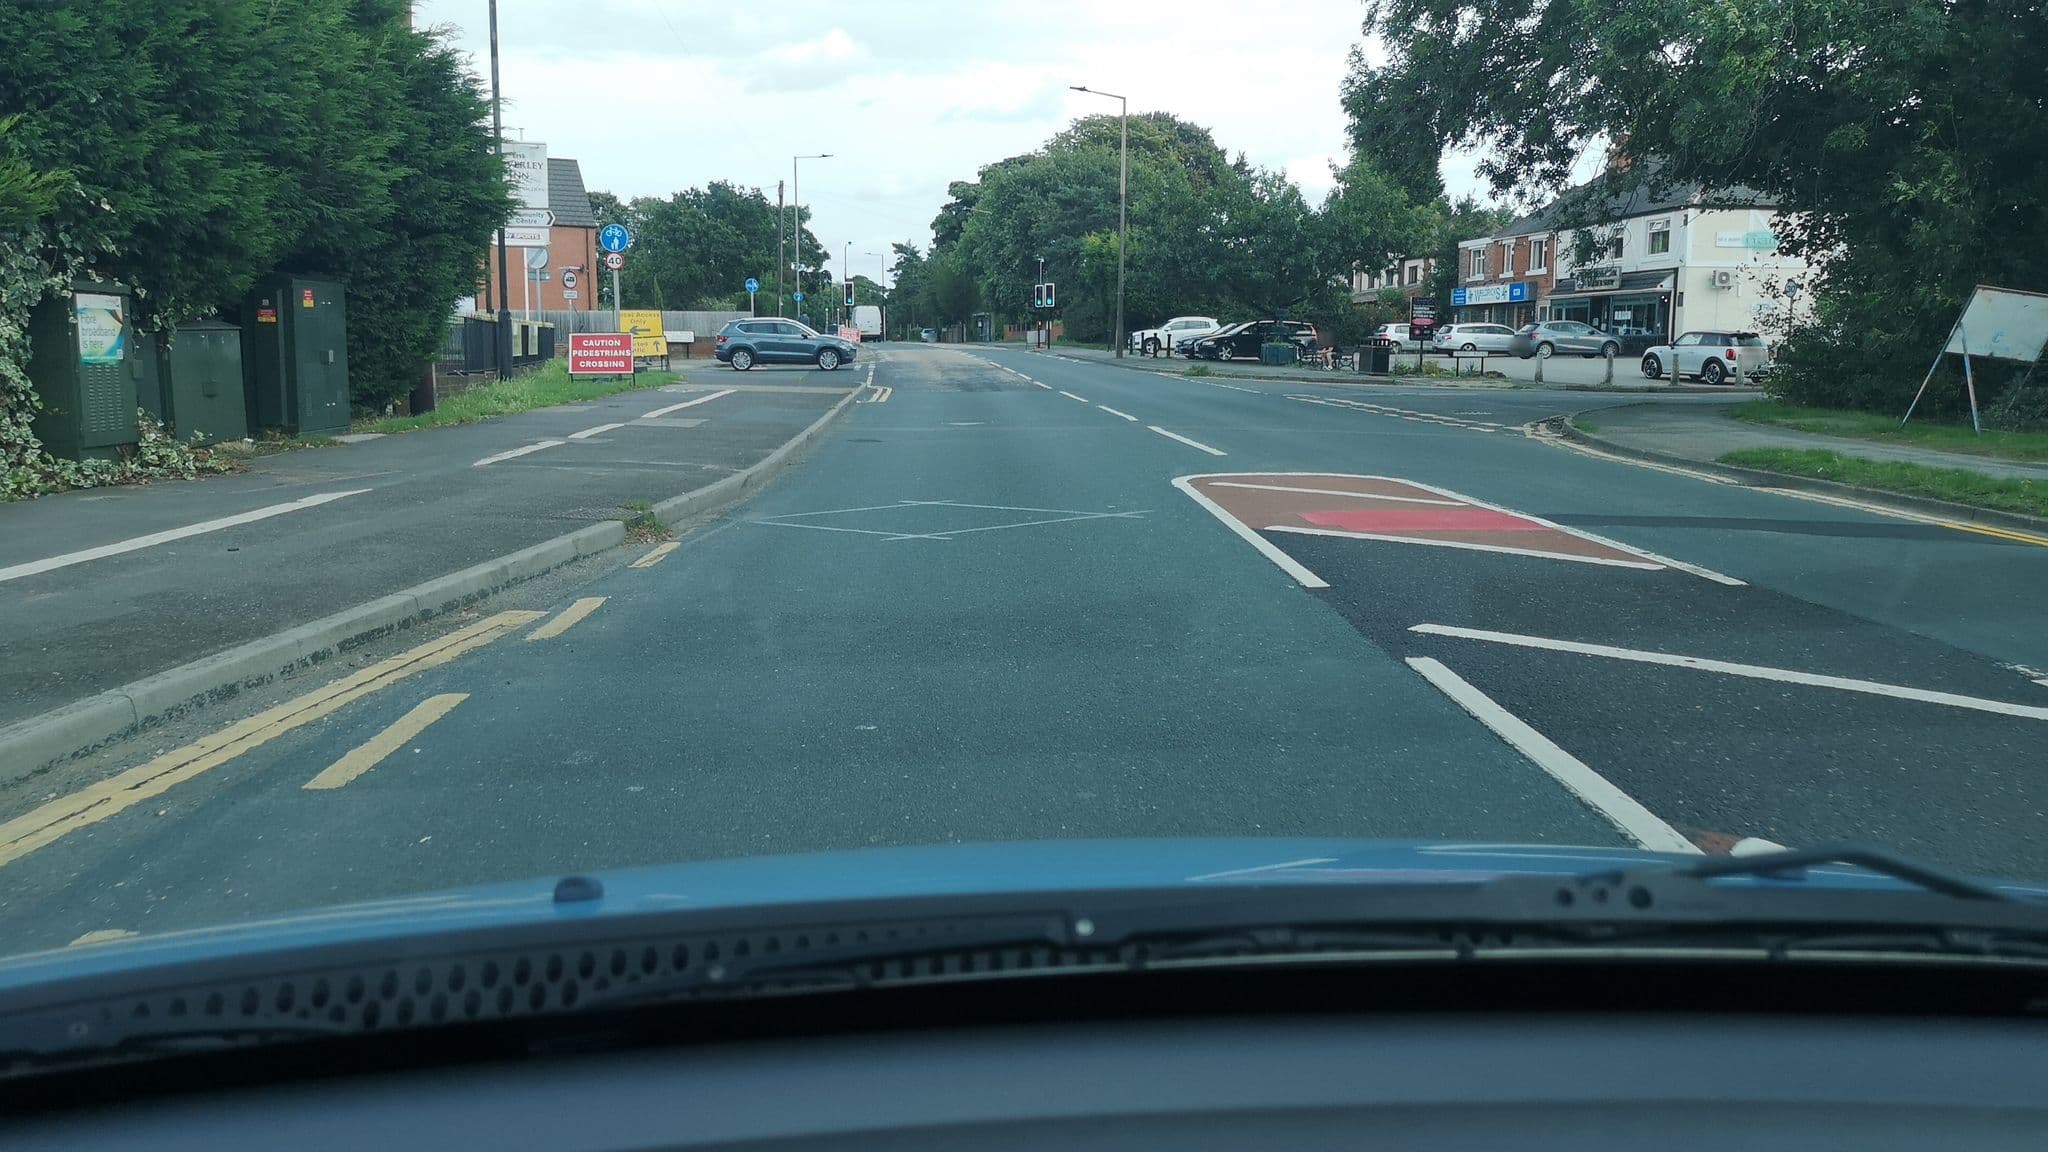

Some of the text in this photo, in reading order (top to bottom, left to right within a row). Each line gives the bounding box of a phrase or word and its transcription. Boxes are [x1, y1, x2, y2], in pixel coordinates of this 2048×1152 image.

[608, 257, 622, 265] 40
[81, 328, 116, 337] broadband
[582, 339, 621, 347] CAUTION
[572, 349, 631, 357] PEDESTRIANS
[579, 360, 625, 368] CROSSING
